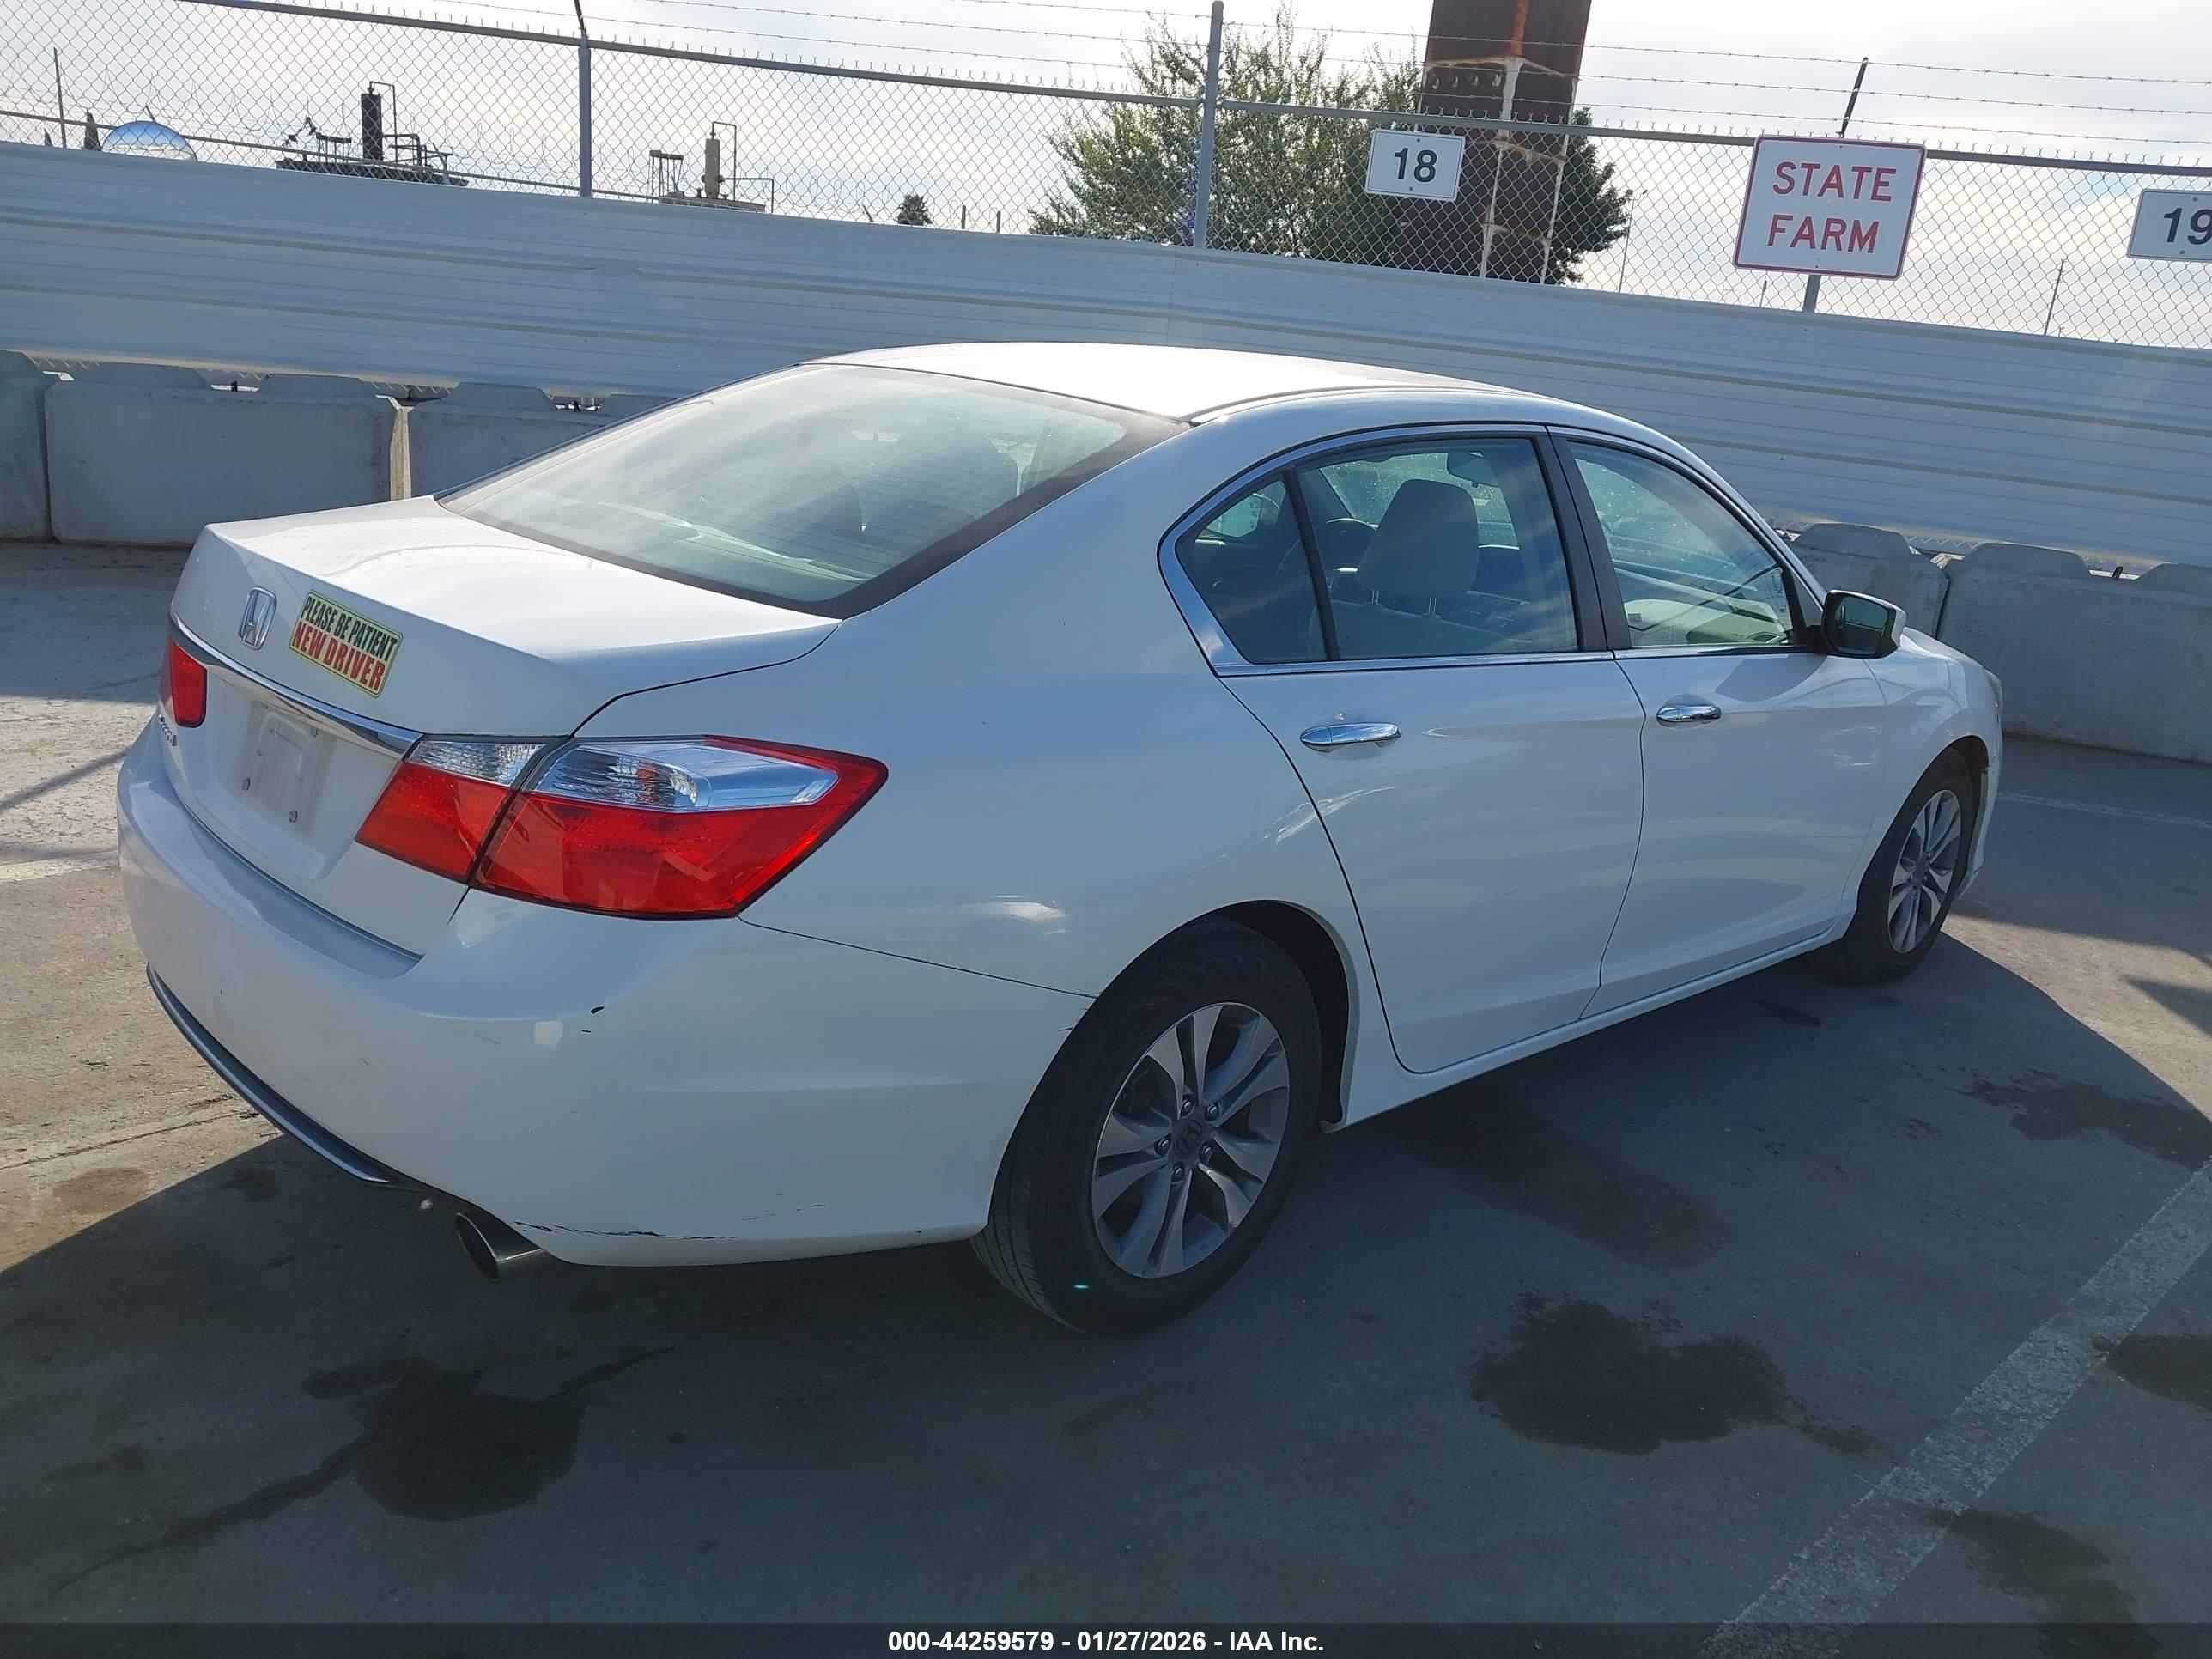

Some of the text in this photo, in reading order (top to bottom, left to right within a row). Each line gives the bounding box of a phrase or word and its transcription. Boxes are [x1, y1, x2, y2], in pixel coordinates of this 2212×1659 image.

[1394, 147, 1437, 183] 18
[1772, 161, 1897, 202] STATE
[1767, 214, 1880, 254] FARM
[2164, 208, 2212, 245] 19
[300, 595, 398, 662] PLEASE BE PATIENT
[292, 621, 386, 691] NEW DRIVER
